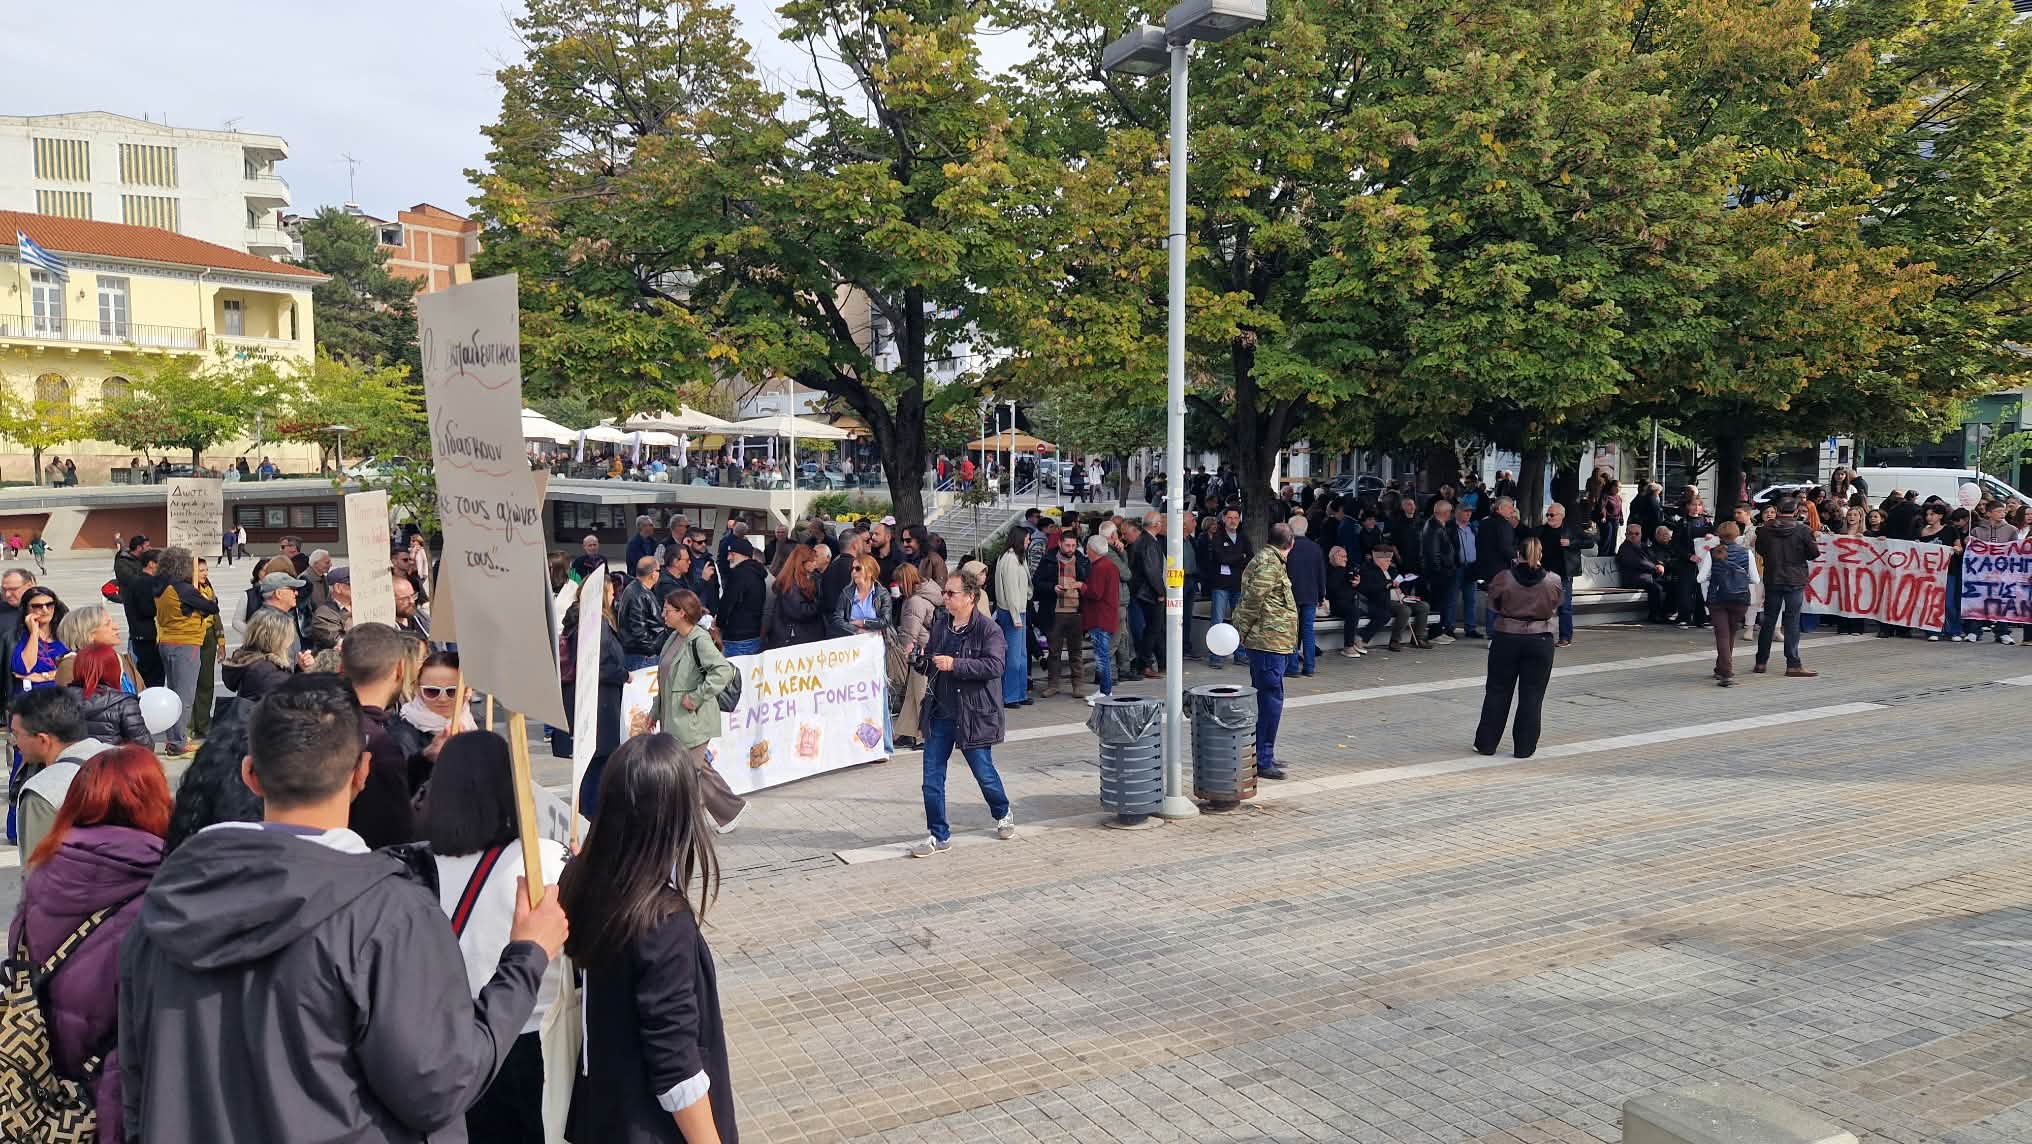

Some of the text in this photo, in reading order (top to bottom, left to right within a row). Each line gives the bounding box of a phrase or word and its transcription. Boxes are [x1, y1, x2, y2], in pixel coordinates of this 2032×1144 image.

[775, 648, 860, 674] ΚΑΛΥΦΘΟΥΝ
[755, 675, 822, 700] ΤΑ ΚΕΝΑ
[730, 679, 881, 731] ΕΝΩΣΗ ΓΟΝΕΩΝ
